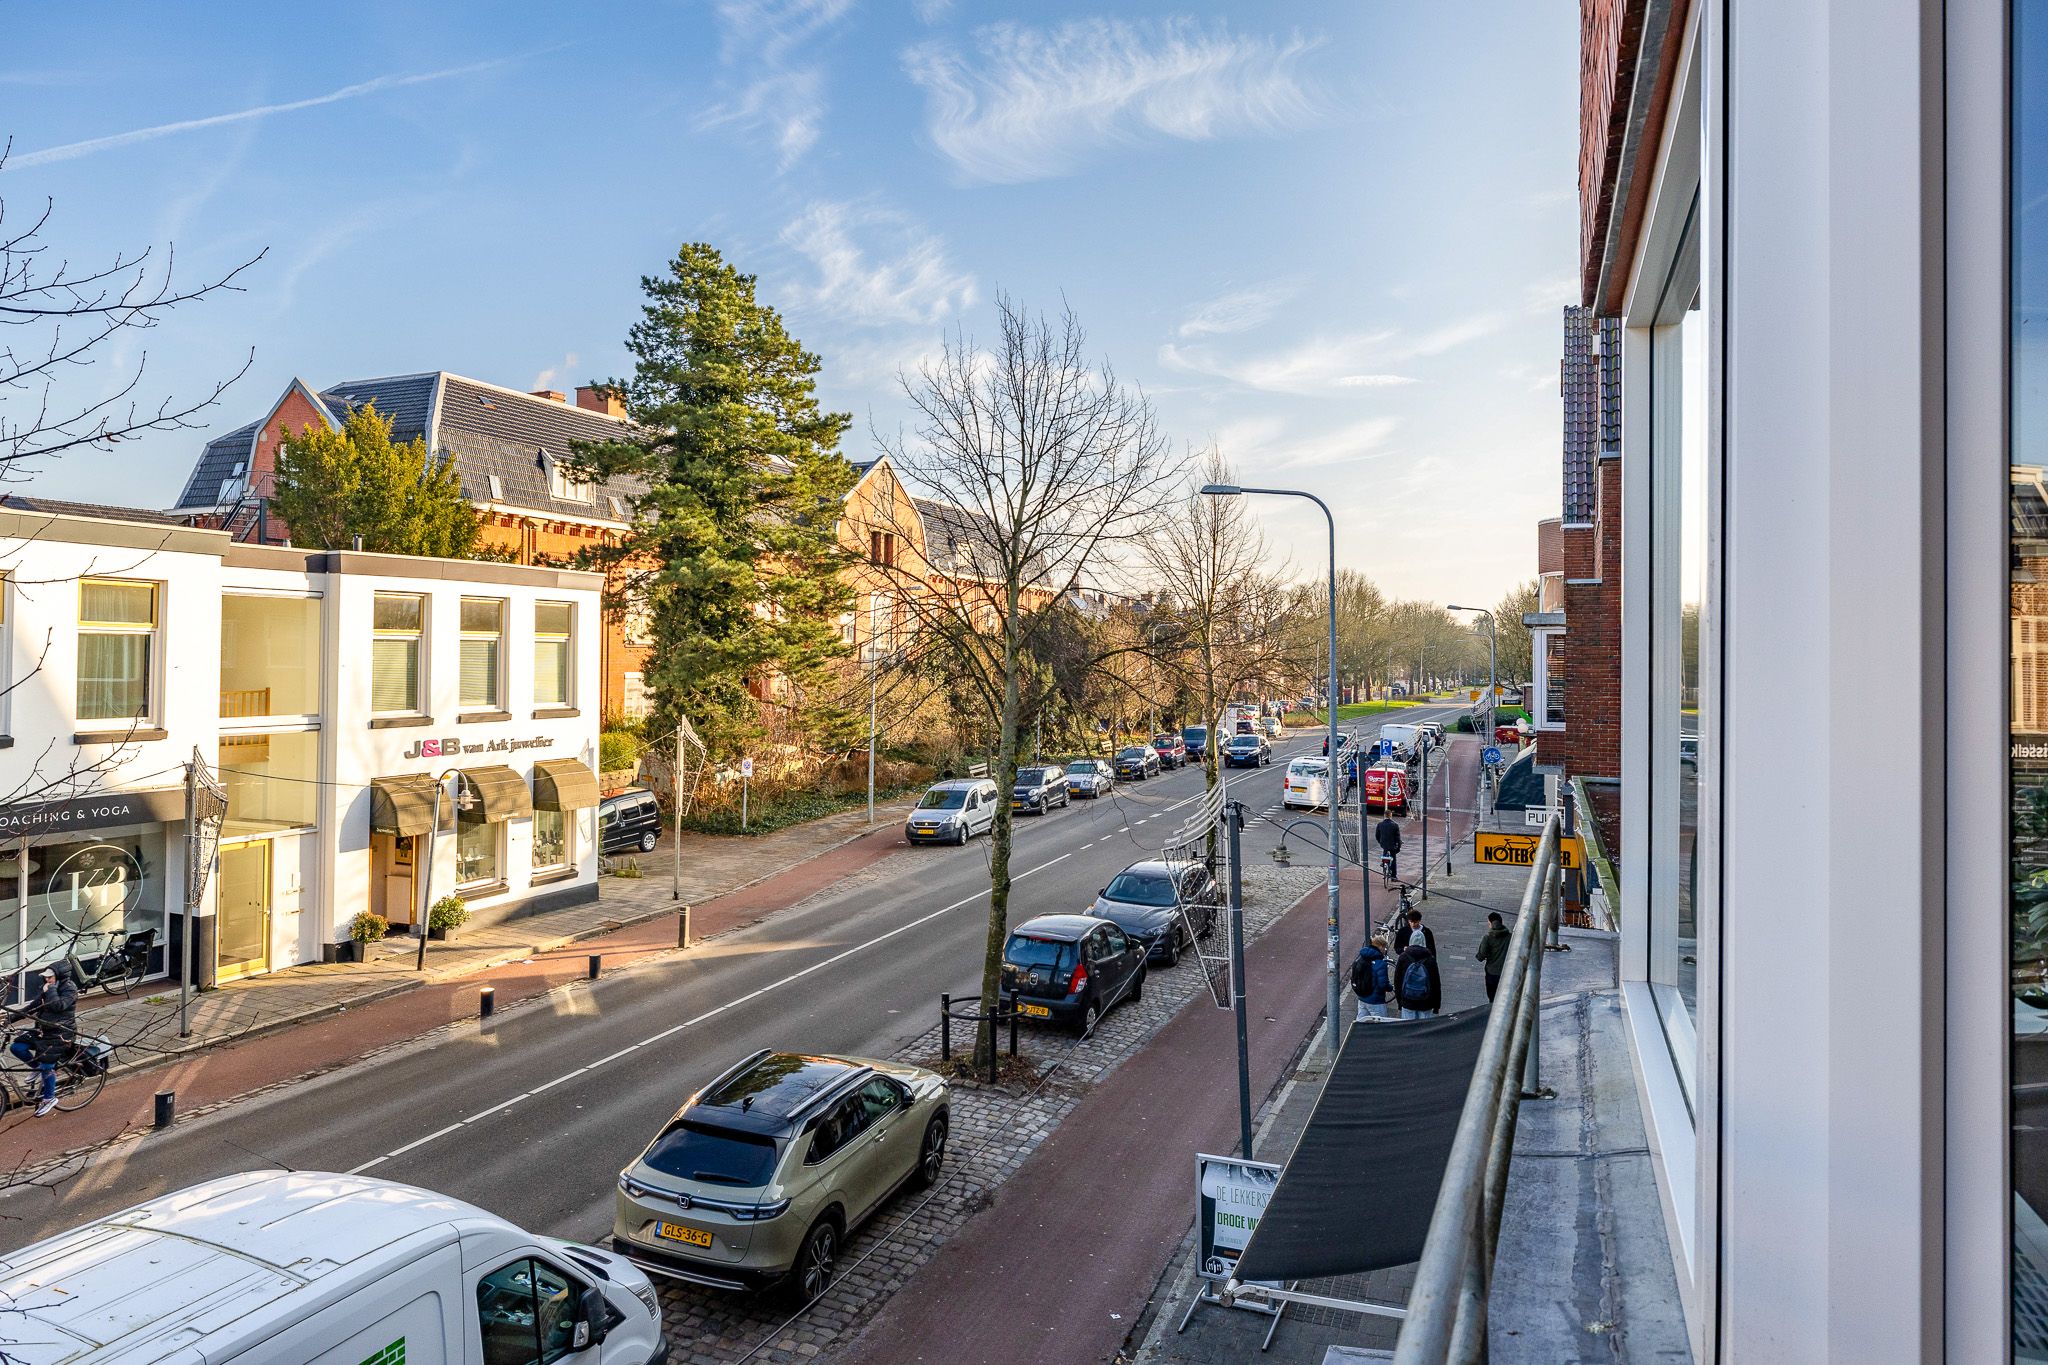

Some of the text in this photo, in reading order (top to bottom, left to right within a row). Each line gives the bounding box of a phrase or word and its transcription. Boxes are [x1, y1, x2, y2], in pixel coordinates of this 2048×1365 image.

[404, 738, 461, 760] J&B
[0, 805, 130, 827] OACHING & YOGA
[1216, 1185, 1227, 1202] DE
[1217, 1212, 1246, 1230] DROGE
[664, 1224, 708, 1244] GLS-36-G
